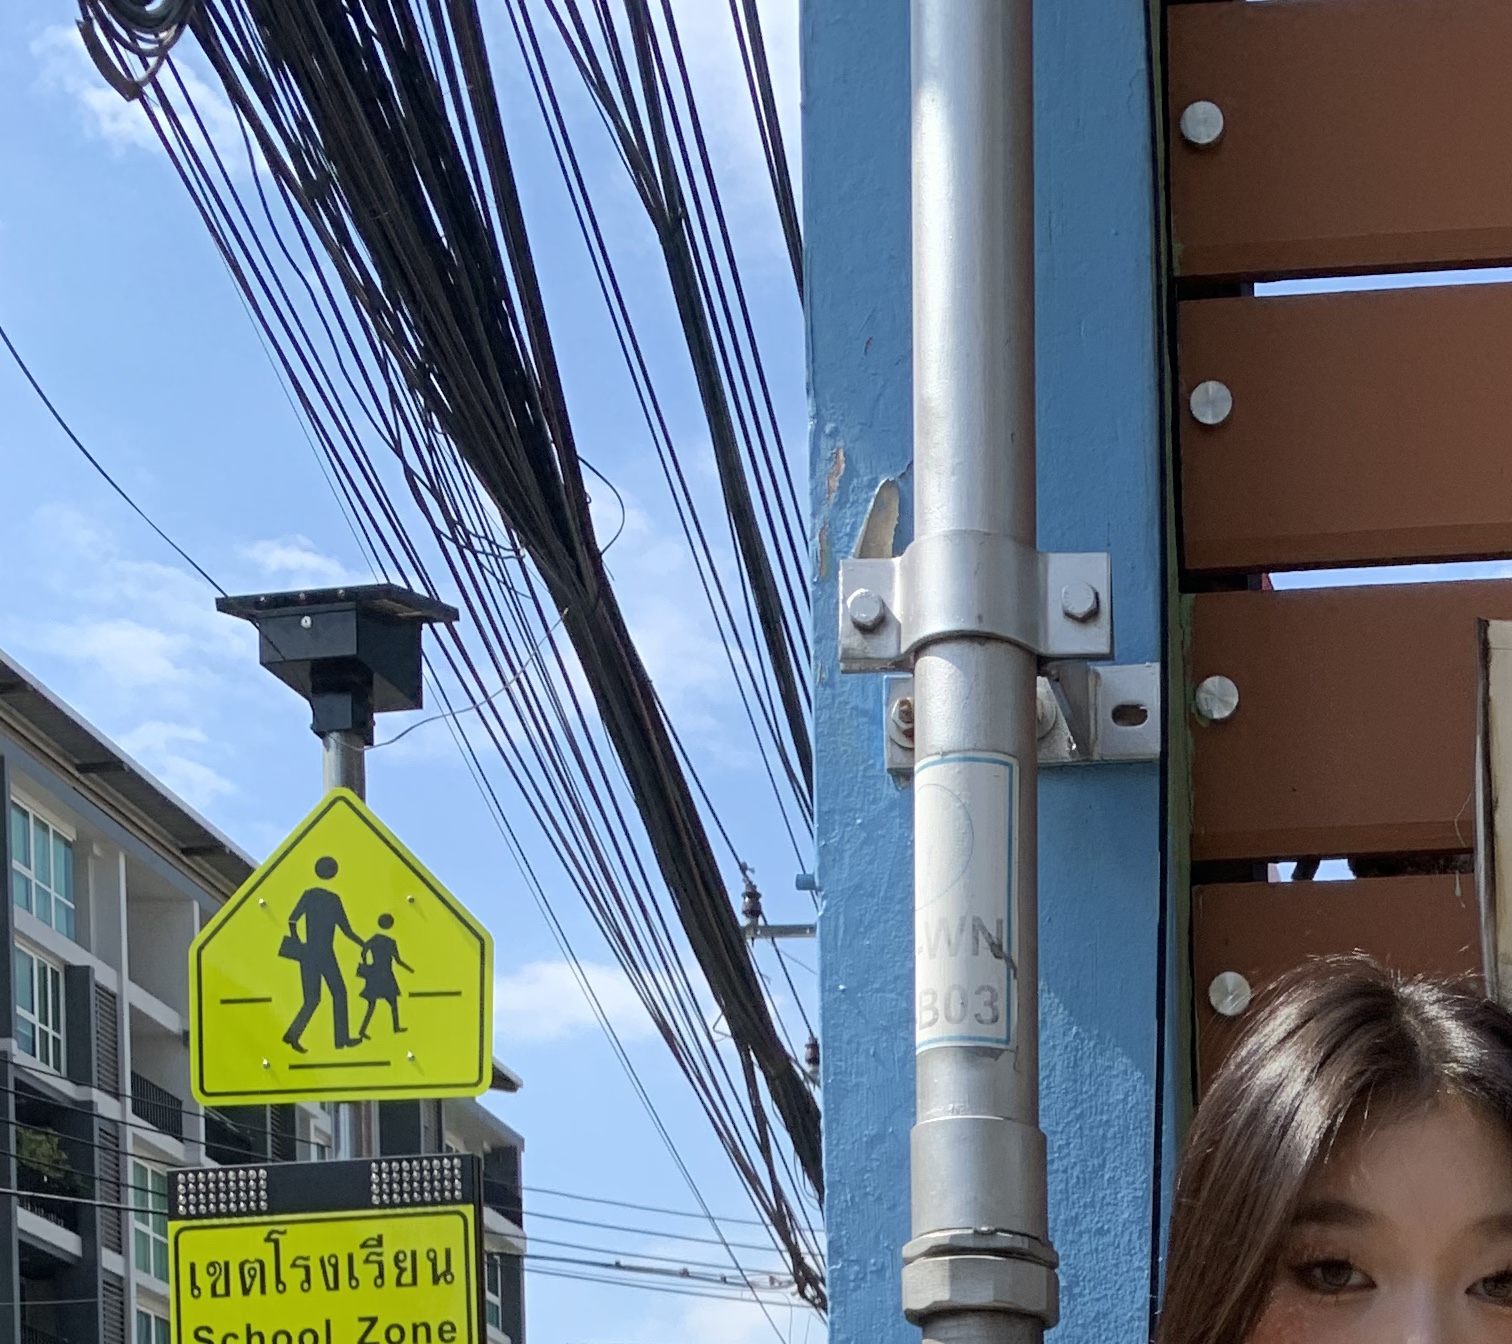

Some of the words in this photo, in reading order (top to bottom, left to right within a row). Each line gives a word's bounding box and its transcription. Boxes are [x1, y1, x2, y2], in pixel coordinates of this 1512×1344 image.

[190, 1228, 455, 1300] เขตโรงเรียน
